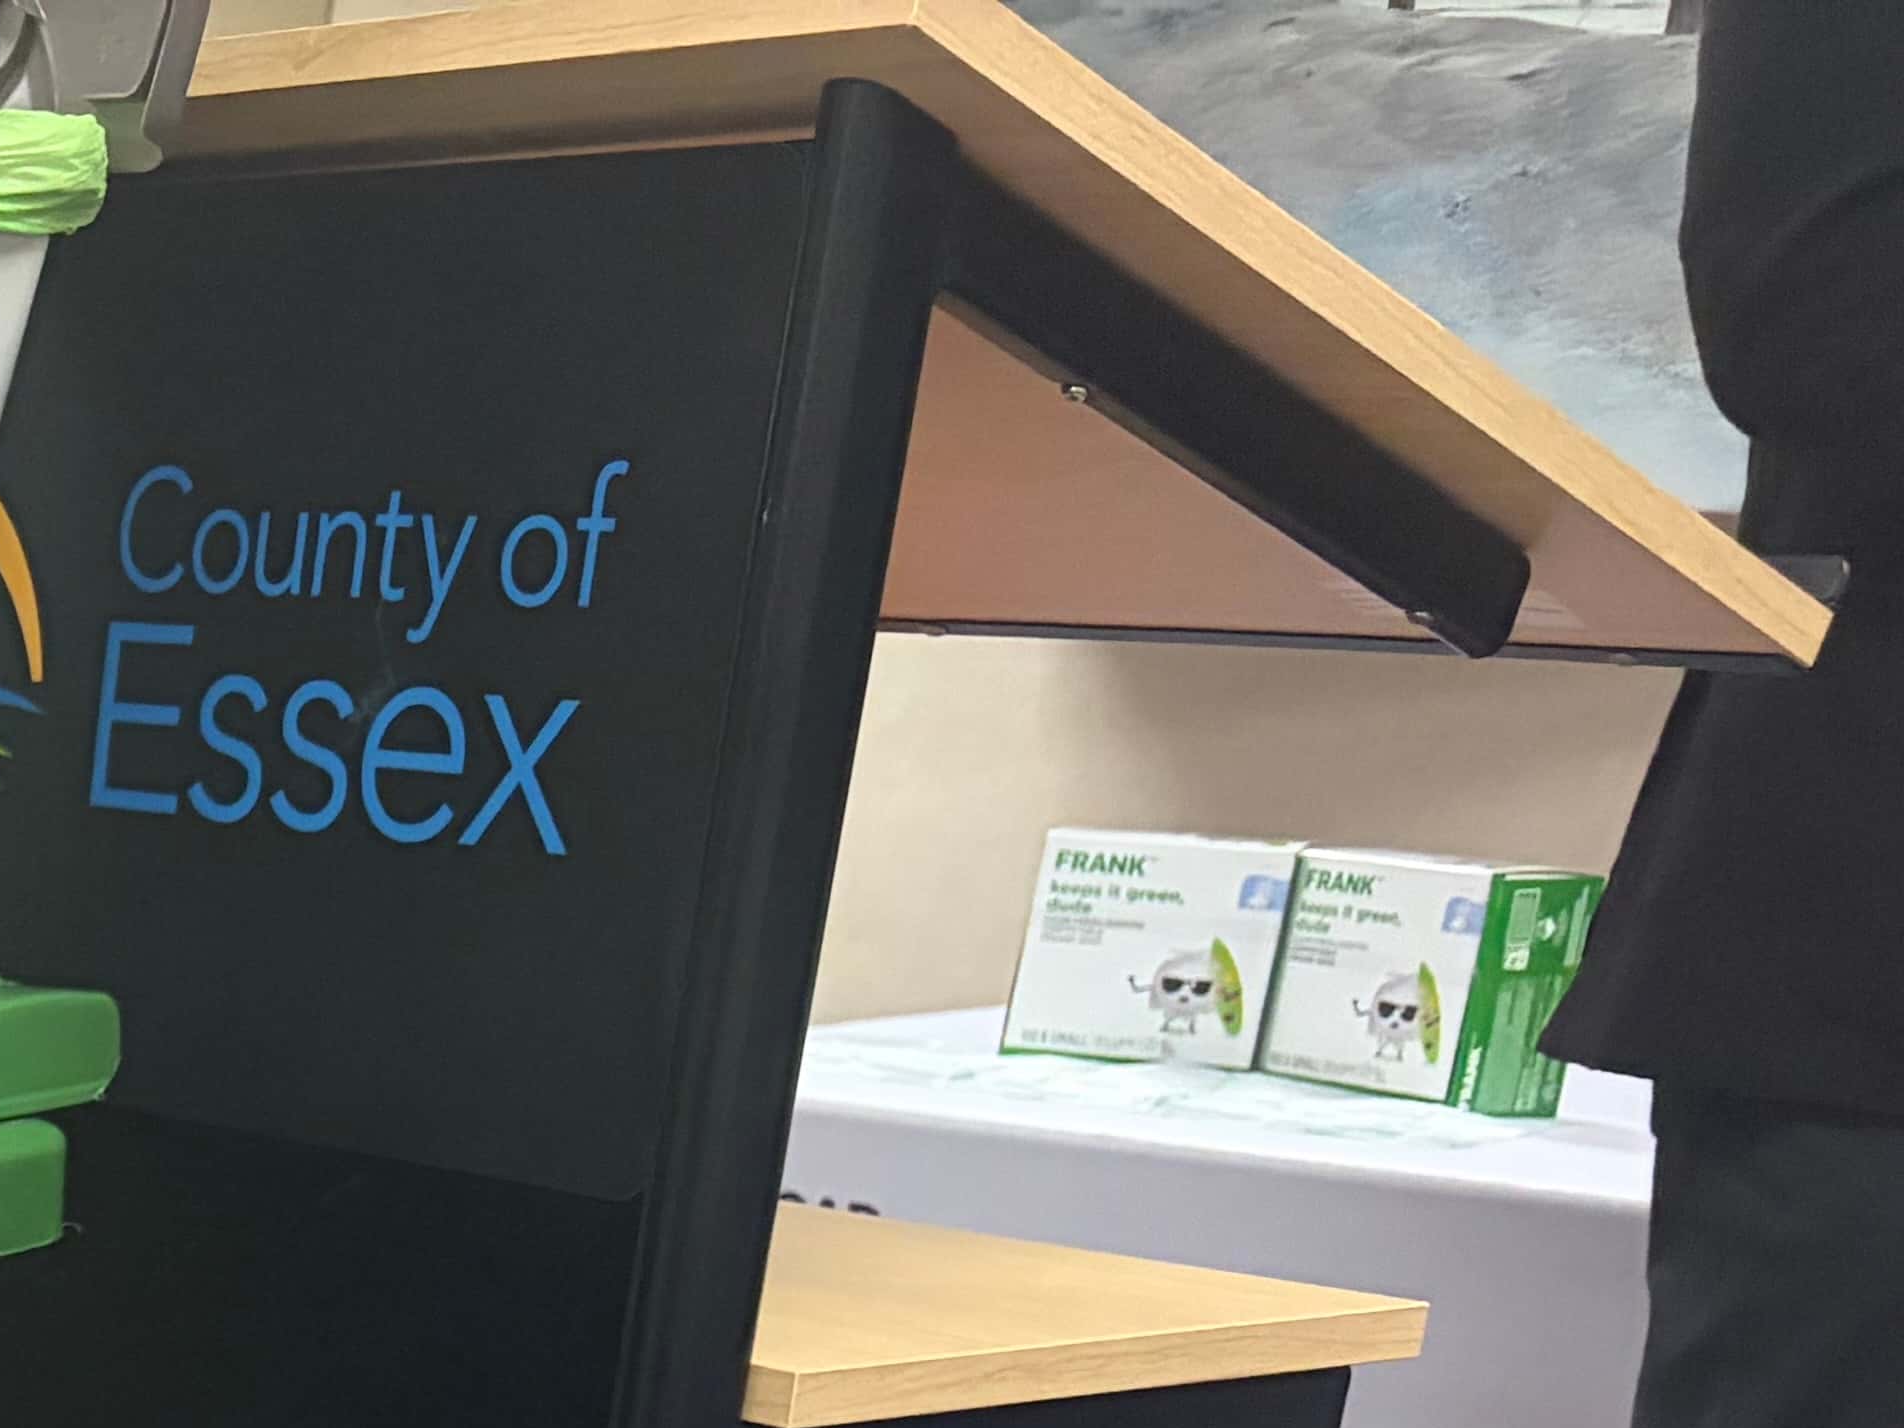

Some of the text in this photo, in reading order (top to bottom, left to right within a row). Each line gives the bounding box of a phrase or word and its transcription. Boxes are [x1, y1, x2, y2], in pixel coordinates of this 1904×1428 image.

[120, 459, 631, 644] County of
[90, 620, 582, 856] Essex
[1054, 848, 1146, 877] FRANK
[1050, 880, 1103, 898] keeps
[1305, 868, 1376, 896] FRANK
